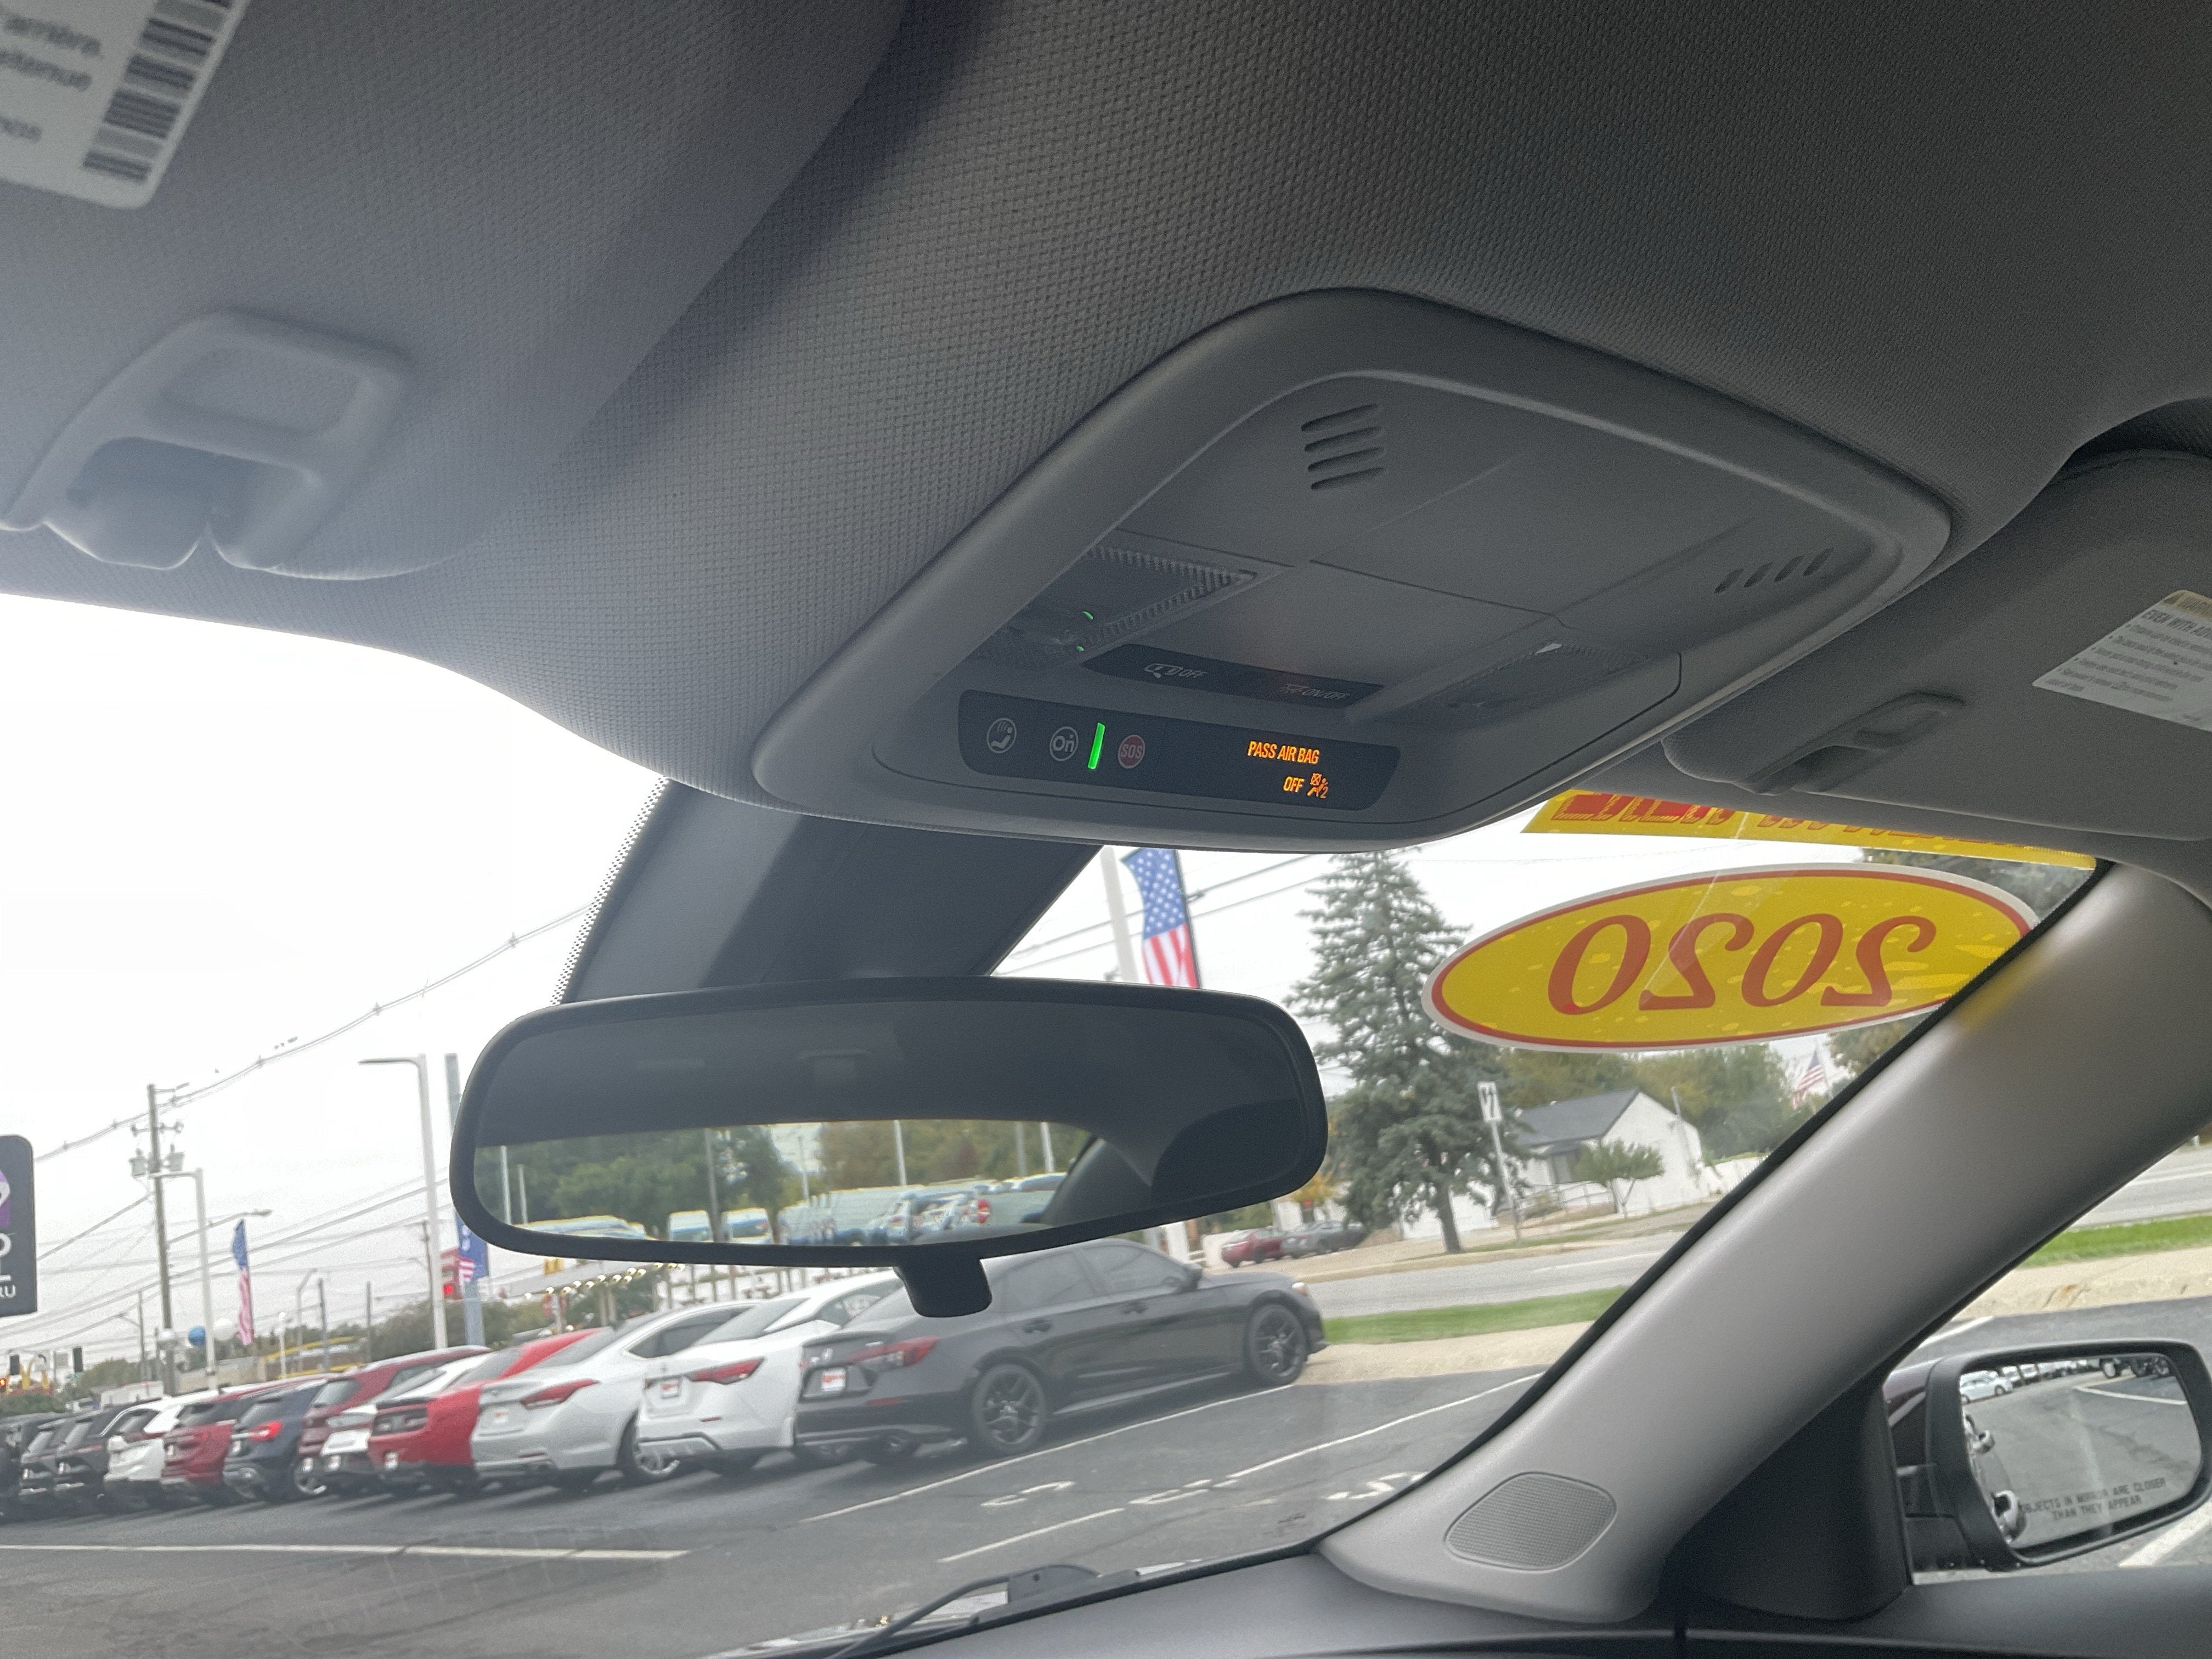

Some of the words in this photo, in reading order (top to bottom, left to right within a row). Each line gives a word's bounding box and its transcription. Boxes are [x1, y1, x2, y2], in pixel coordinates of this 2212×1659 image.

[2141, 610, 2172, 624] EVEN
[2167, 618, 2198, 632] WITH
[1178, 669, 1207, 679] OFF
[1121, 743, 1143, 759] SOS
[1247, 740, 1278, 759] PASS
[1277, 745, 1297, 762] AIR
[1297, 747, 1321, 764] BAG
[1283, 776, 1305, 793] OFF
[2064, 1496, 2073, 1505] IN
[2113, 1484, 2130, 1496] ARE
[2108, 1494, 2142, 1510] APPEAR
